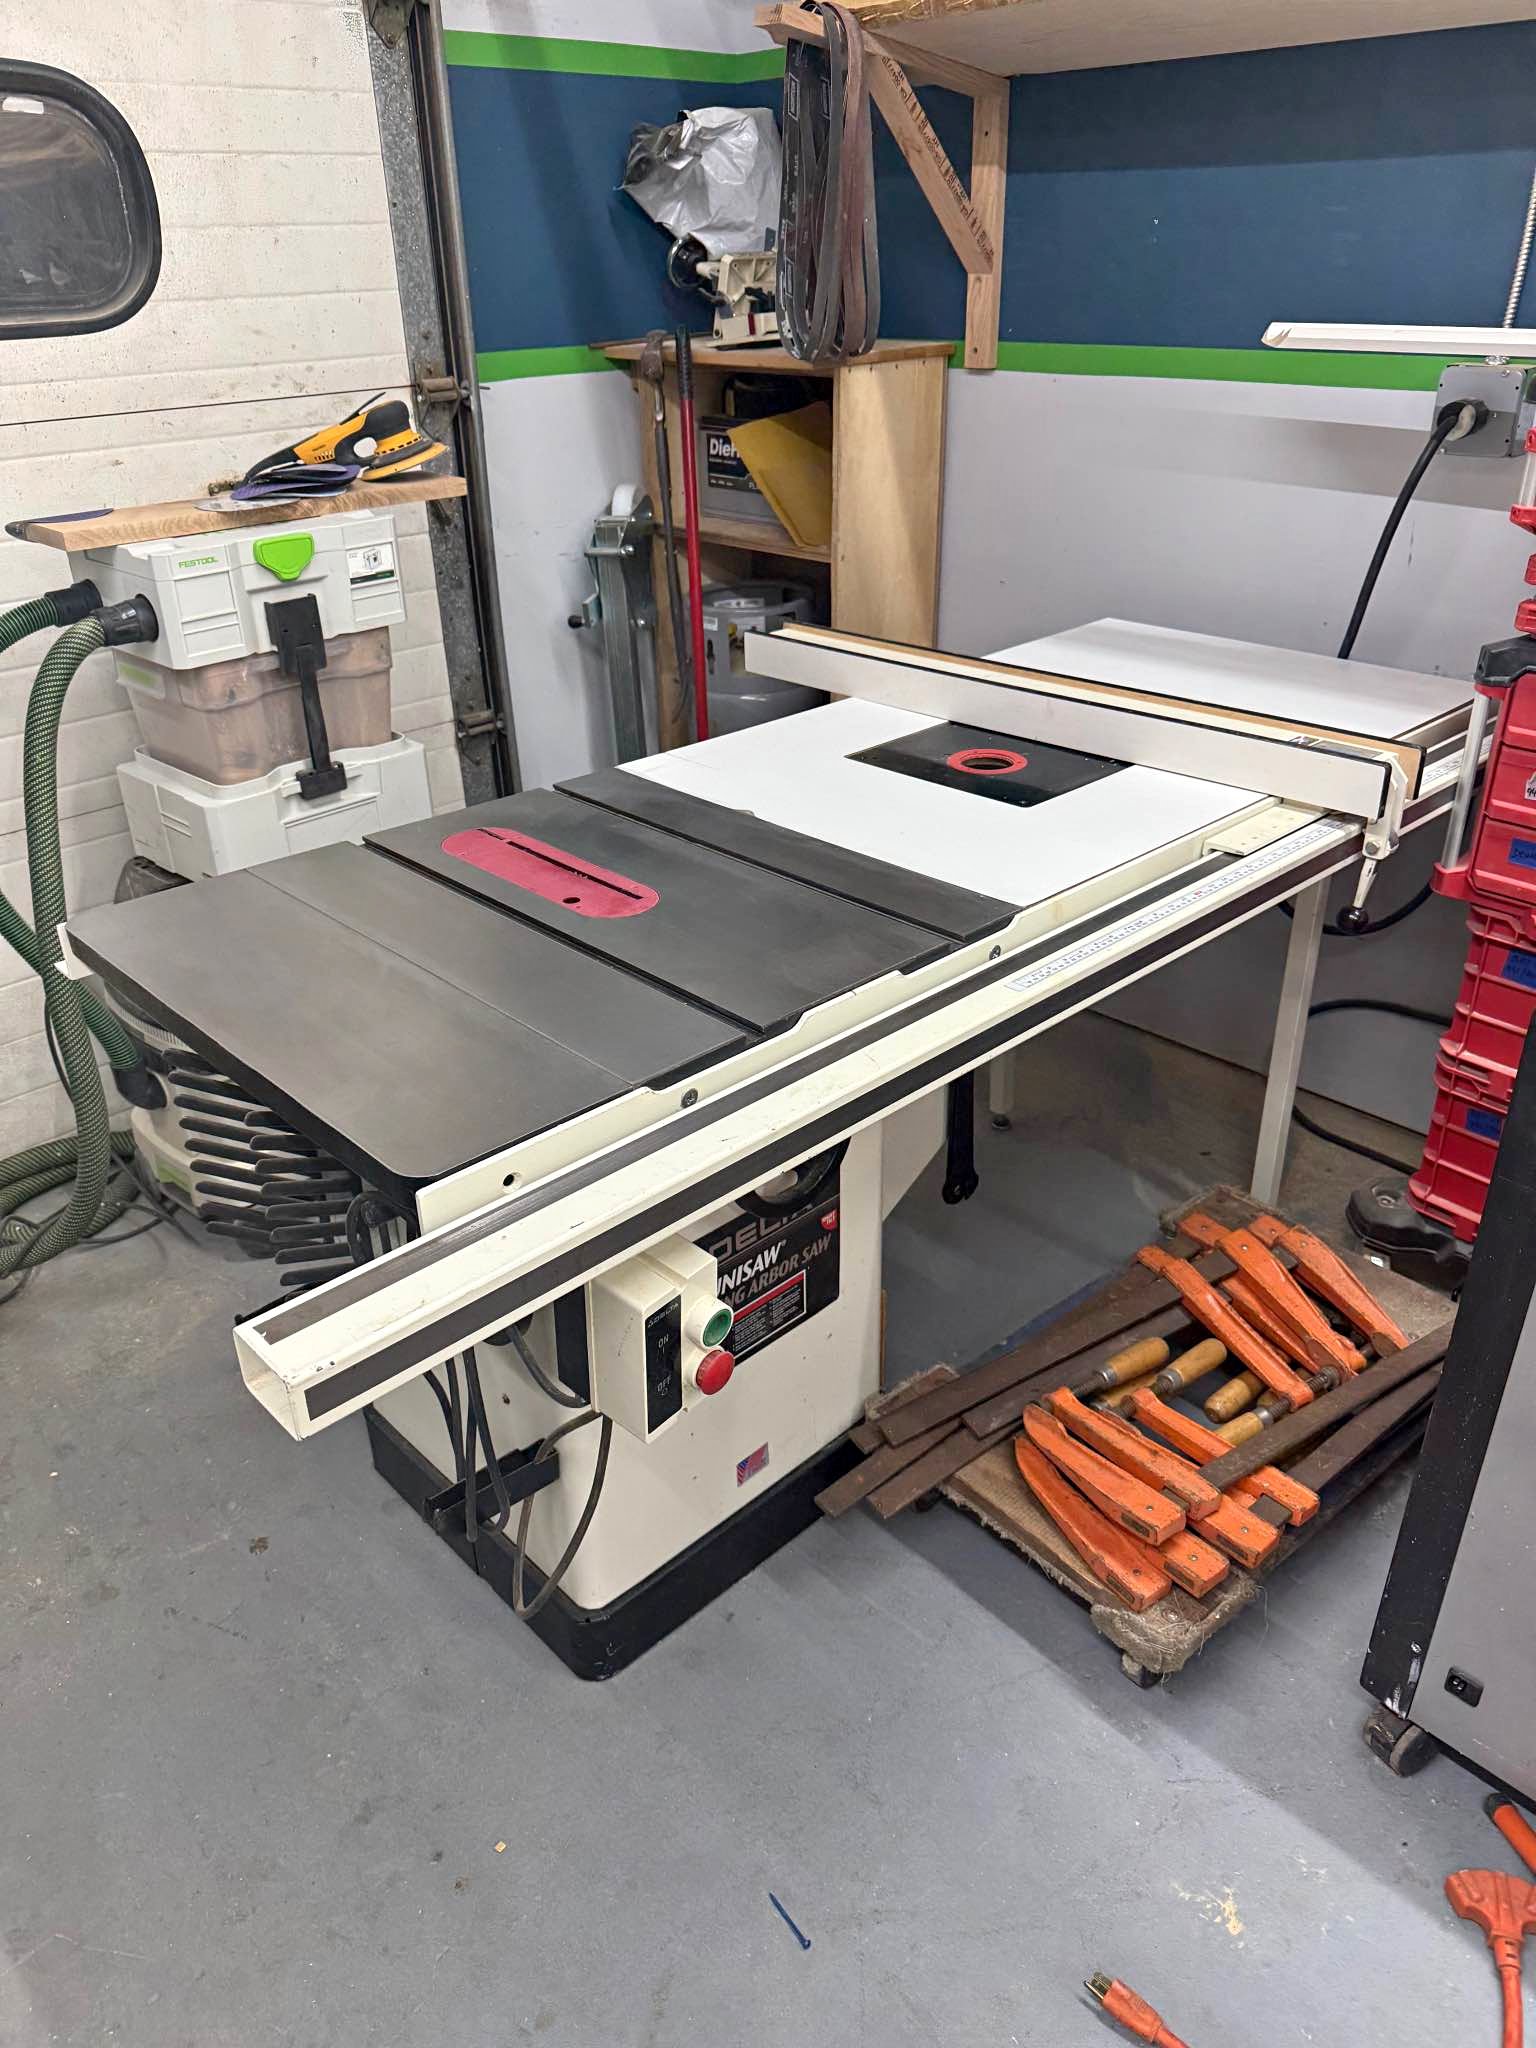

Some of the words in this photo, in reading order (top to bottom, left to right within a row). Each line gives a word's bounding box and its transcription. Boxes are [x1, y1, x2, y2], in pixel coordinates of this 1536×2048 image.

[748, 1254, 799, 1296] ARBOR
[801, 1233, 832, 1263] SAW
[658, 1333, 669, 1348] ON
[657, 1375, 671, 1392] OFF
